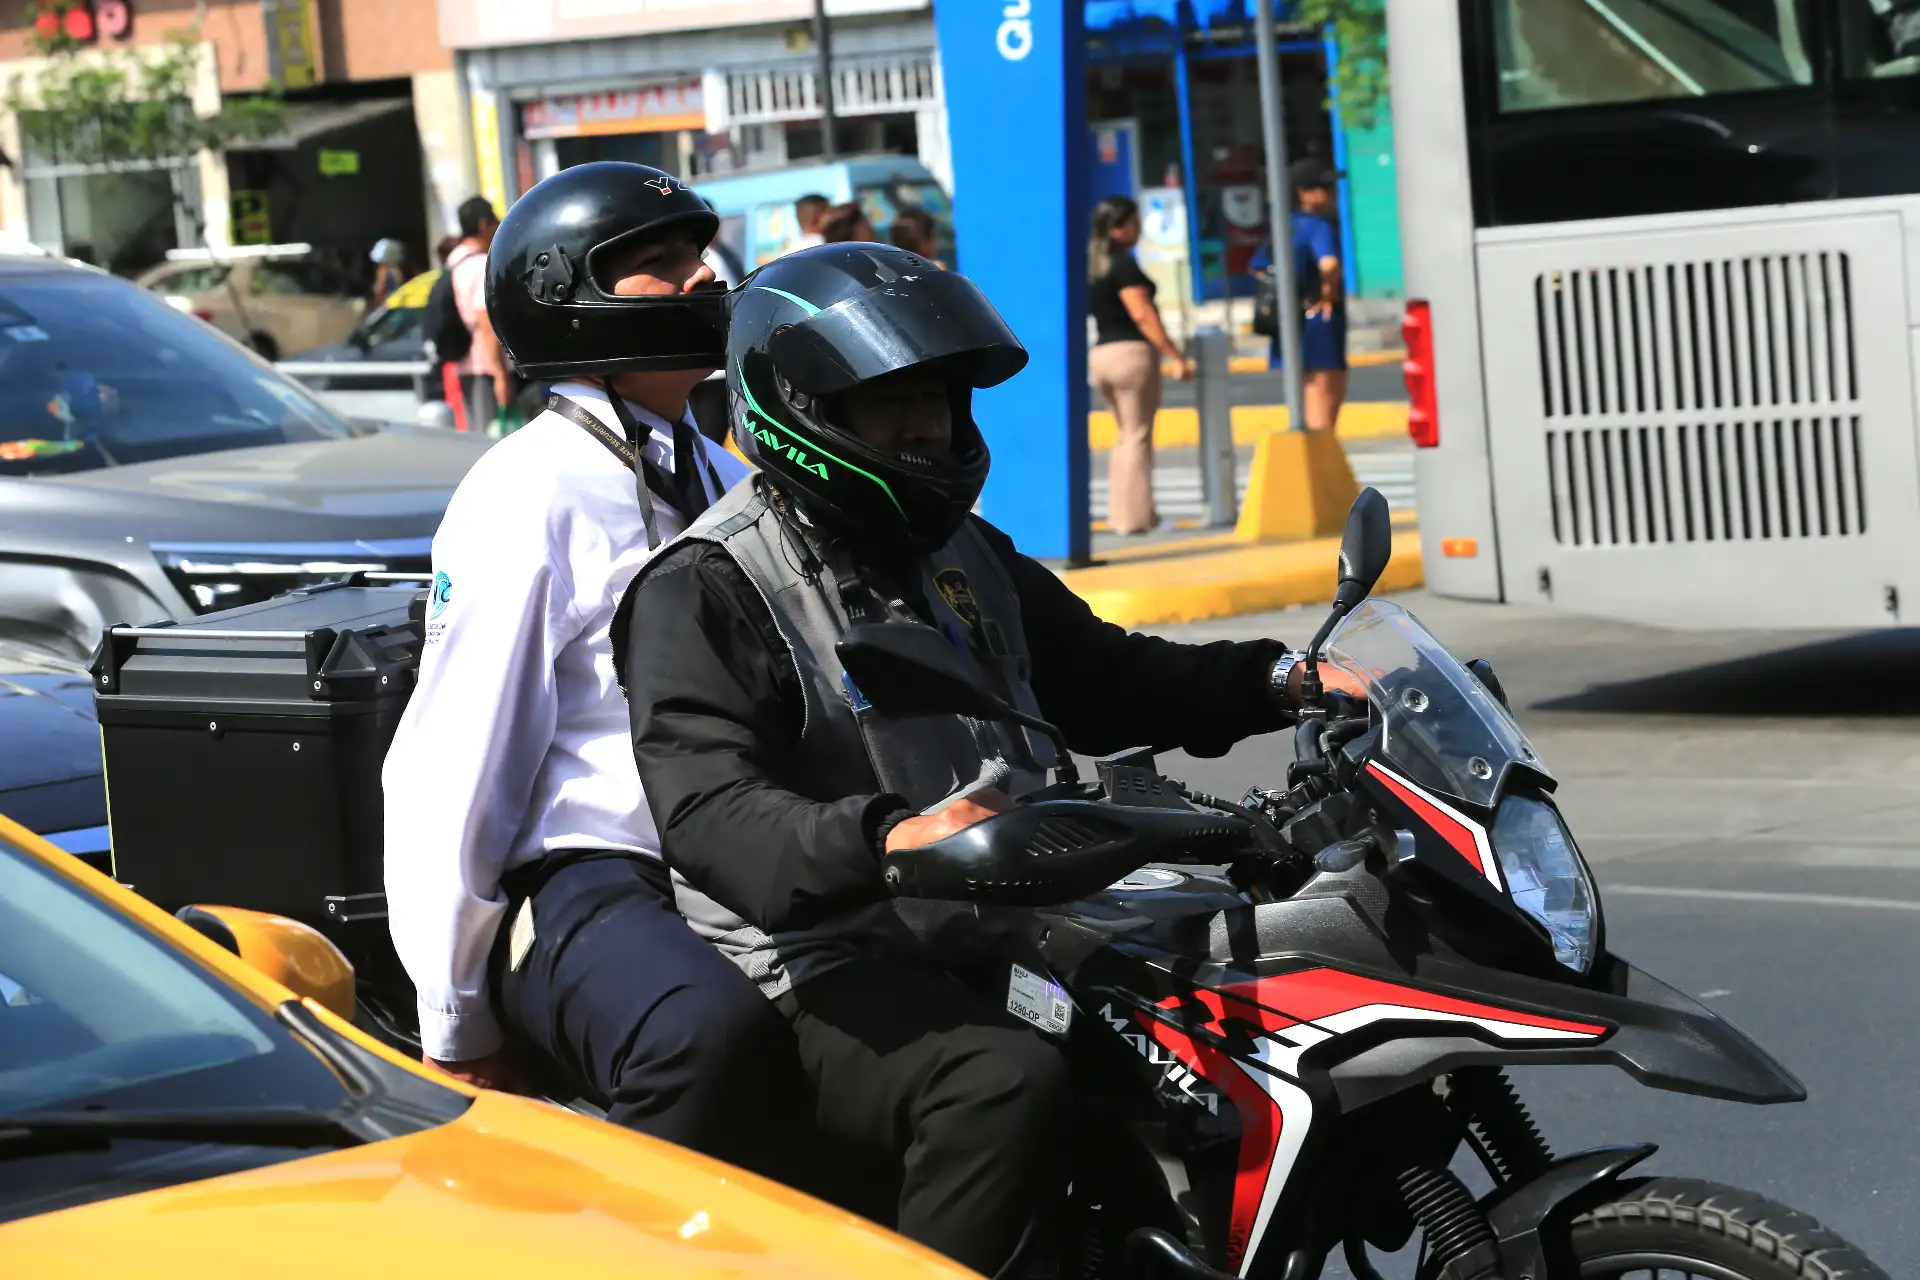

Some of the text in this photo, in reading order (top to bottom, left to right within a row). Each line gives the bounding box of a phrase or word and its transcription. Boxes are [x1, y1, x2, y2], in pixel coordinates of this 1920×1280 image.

[591, 422, 621, 448] SECURITY
[741, 412, 829, 481] MAVILA
[619, 444, 637, 463] RATE
[1009, 1000, 1040, 1022] 1290-OP
[1098, 1002, 1218, 1116] MAVILA
